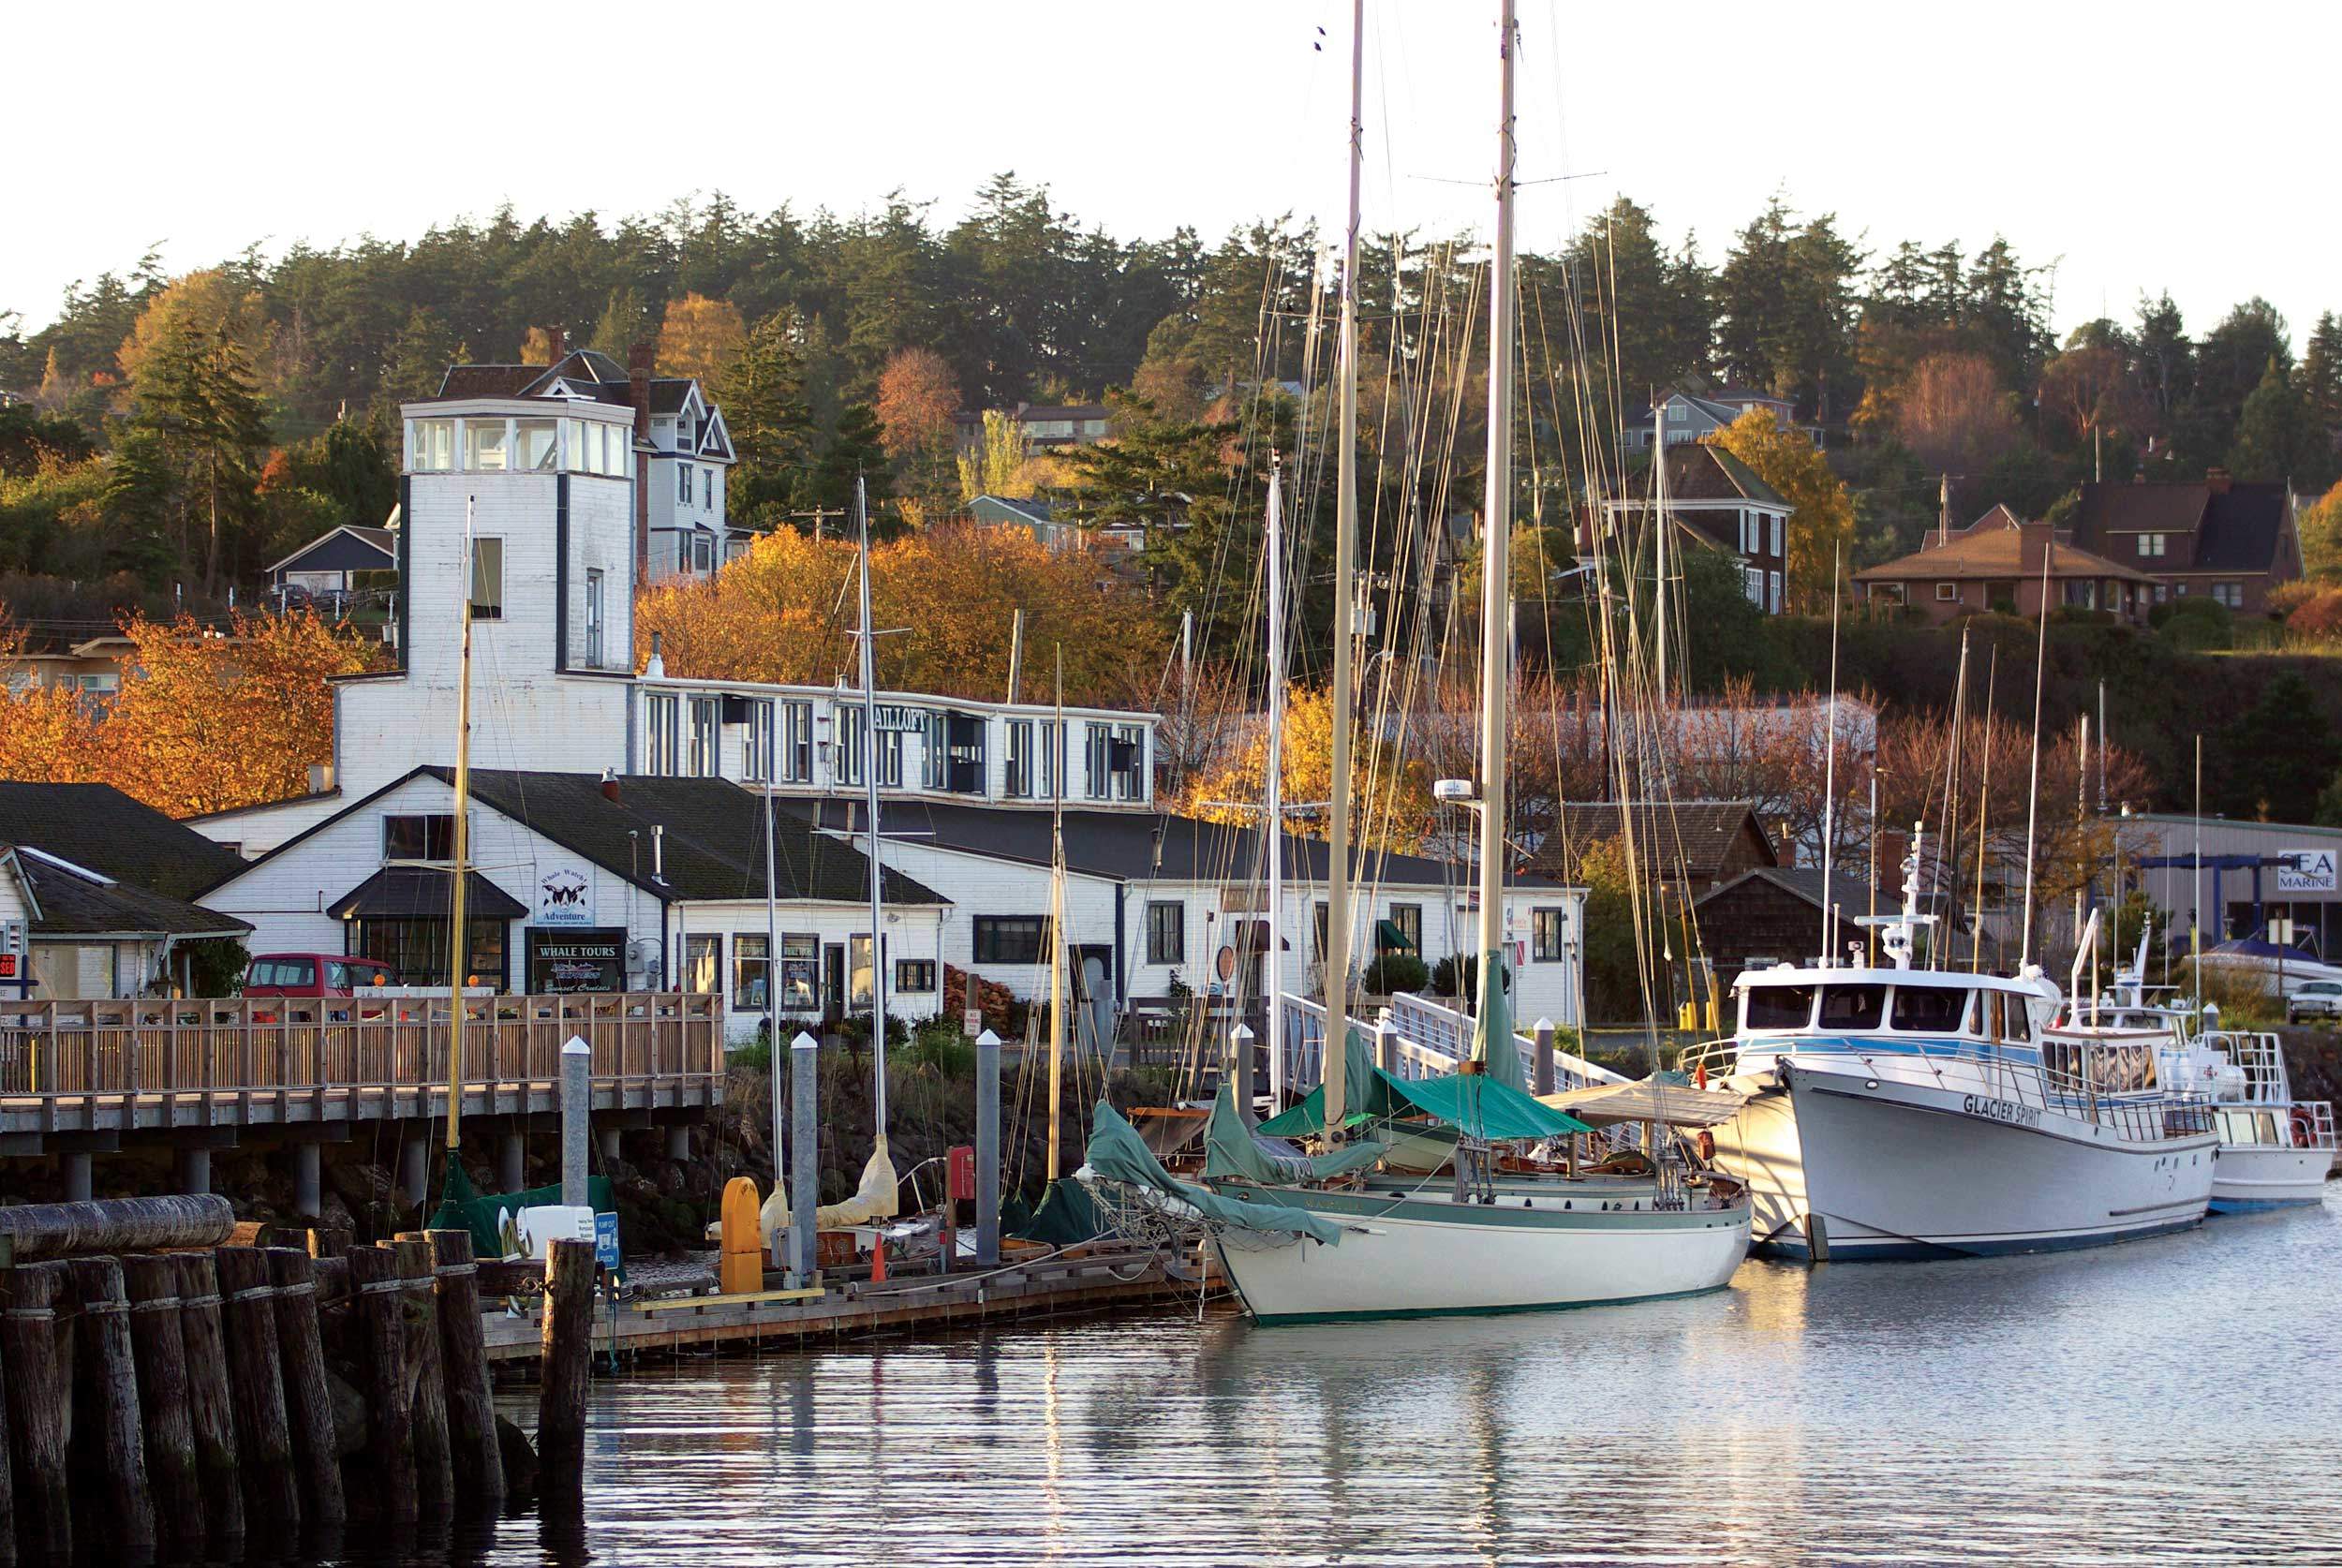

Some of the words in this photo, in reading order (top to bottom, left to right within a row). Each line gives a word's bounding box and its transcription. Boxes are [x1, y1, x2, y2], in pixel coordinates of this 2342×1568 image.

[895, 707, 926, 732] LOFT
[541, 870, 561, 884] Whale
[2280, 877, 2334, 888] MARINE
[544, 911, 586, 921] Adventure
[540, 947, 578, 956] WHALE
[580, 947, 615, 956] TOURS
[544, 984, 575, 992] Sunset
[578, 983, 611, 992] Cruises
[1964, 1094, 2013, 1121] GLACIER
[2015, 1106, 2041, 1128] SPIRIT
